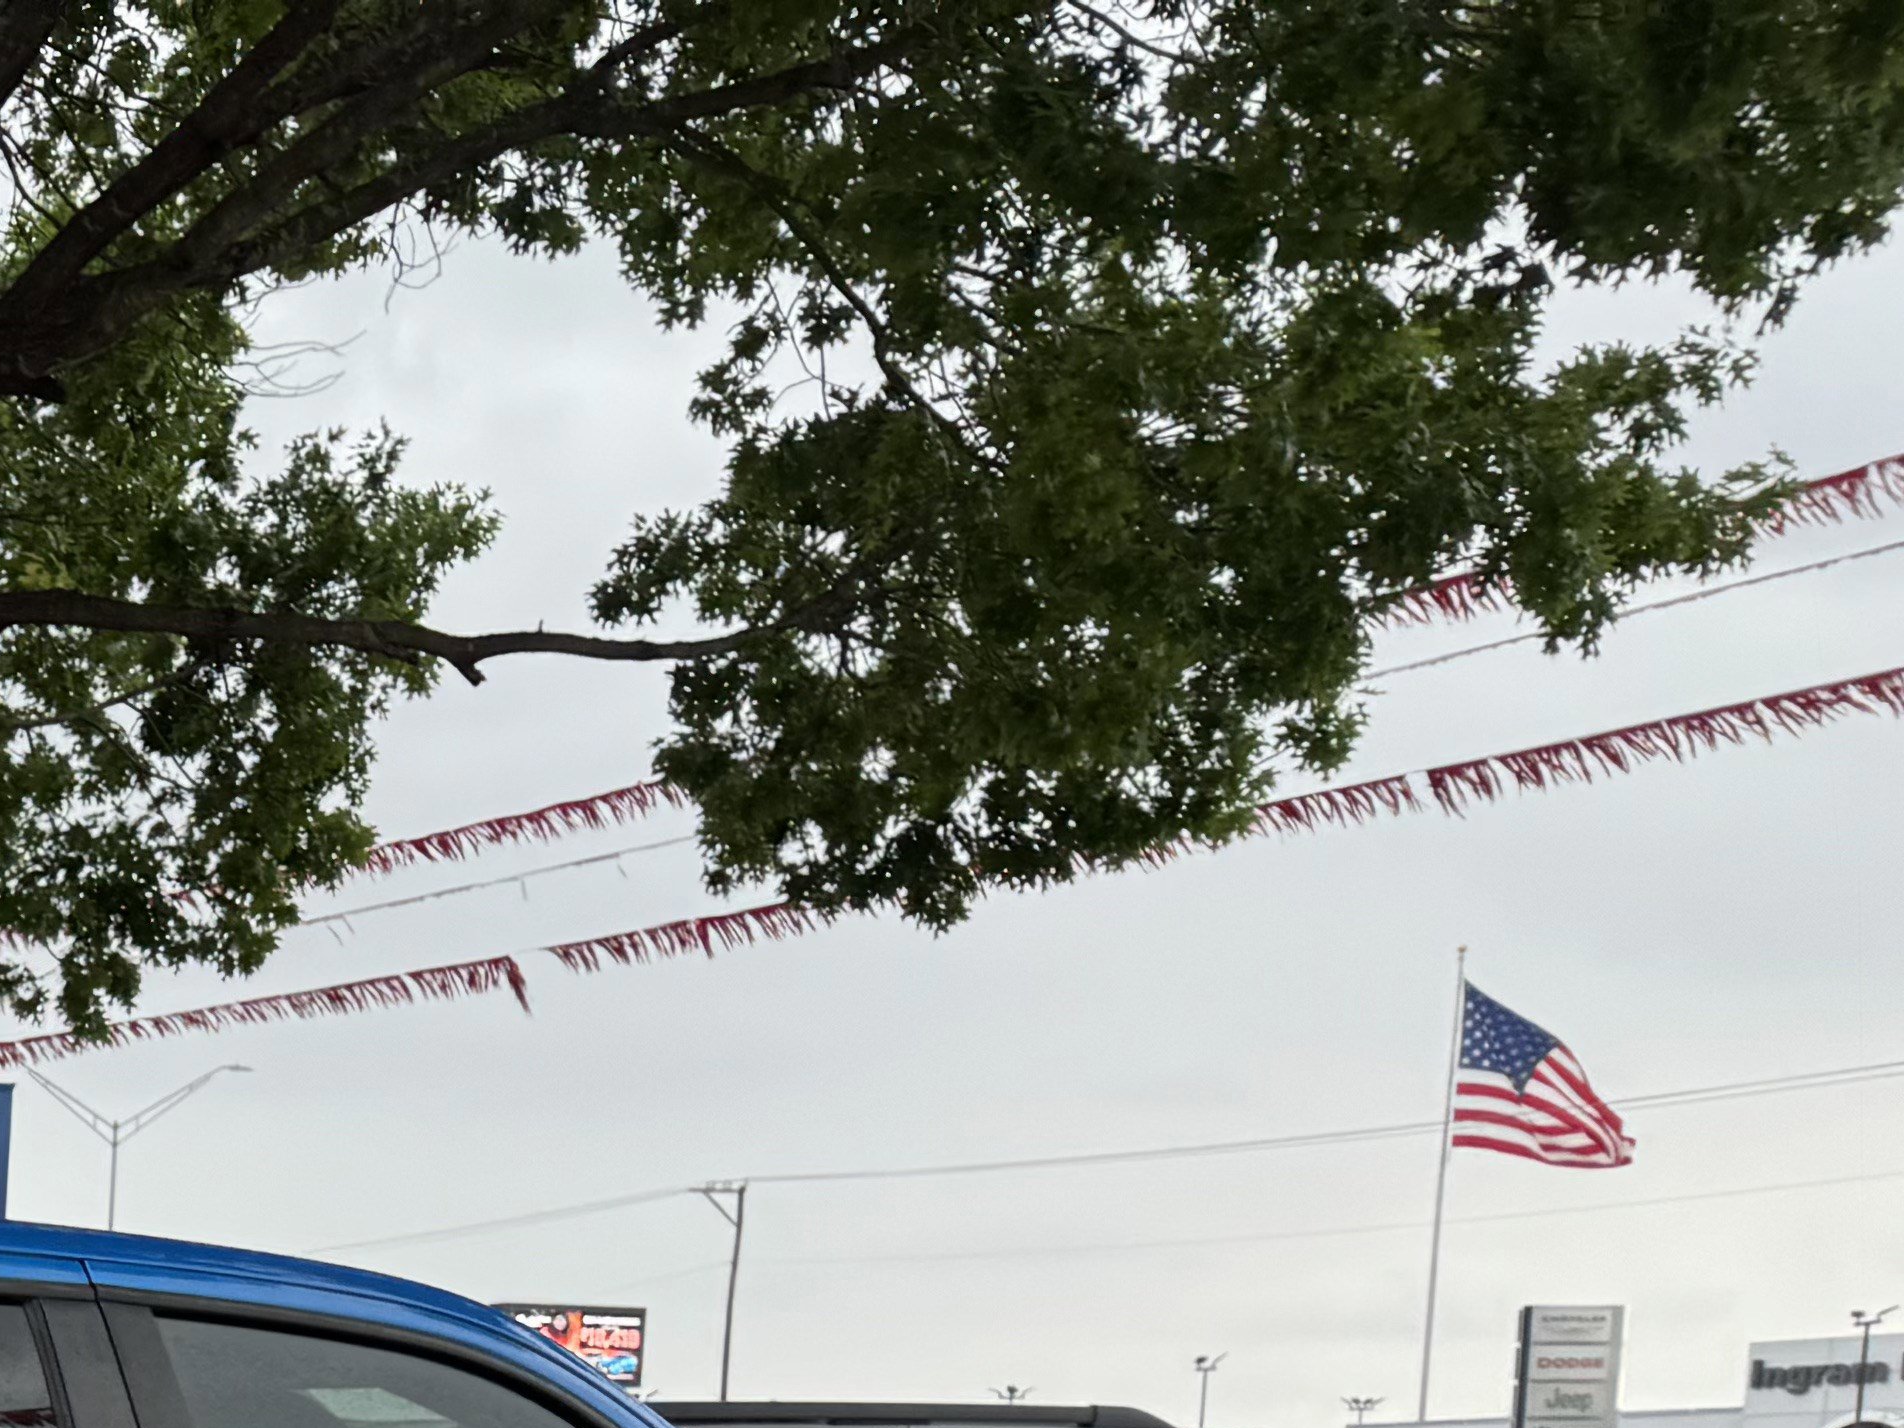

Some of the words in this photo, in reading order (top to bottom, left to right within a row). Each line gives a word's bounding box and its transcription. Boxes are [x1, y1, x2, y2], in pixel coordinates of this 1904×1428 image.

[1536, 1356, 1605, 1369] DODGE
[1750, 1359, 1890, 1395] Ingram
[1545, 1386, 1594, 1413] Jeep
